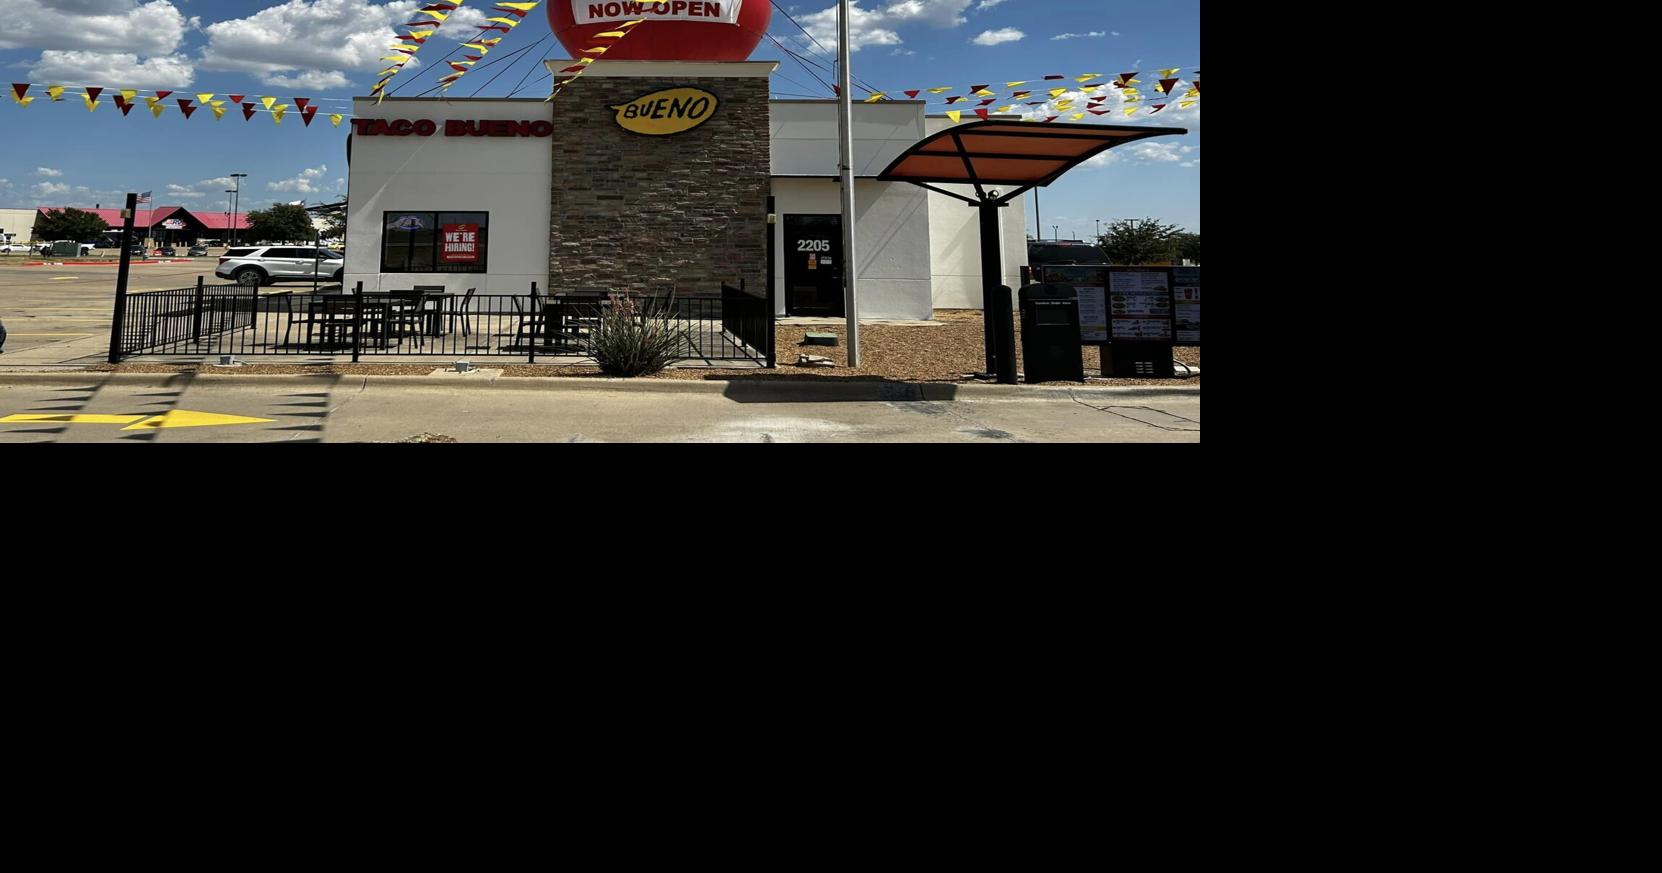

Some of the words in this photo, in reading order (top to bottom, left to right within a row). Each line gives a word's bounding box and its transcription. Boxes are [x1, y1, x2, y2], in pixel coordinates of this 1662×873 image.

[588, 0, 645, 18] NOW
[652, 0, 721, 18] OPEN
[624, 96, 710, 120] BUENO
[350, 118, 437, 137] TACO
[444, 119, 554, 138] BUENO
[445, 231, 475, 242] WE'RE
[444, 242, 475, 252] HIRING!
[797, 239, 830, 252] 2205
